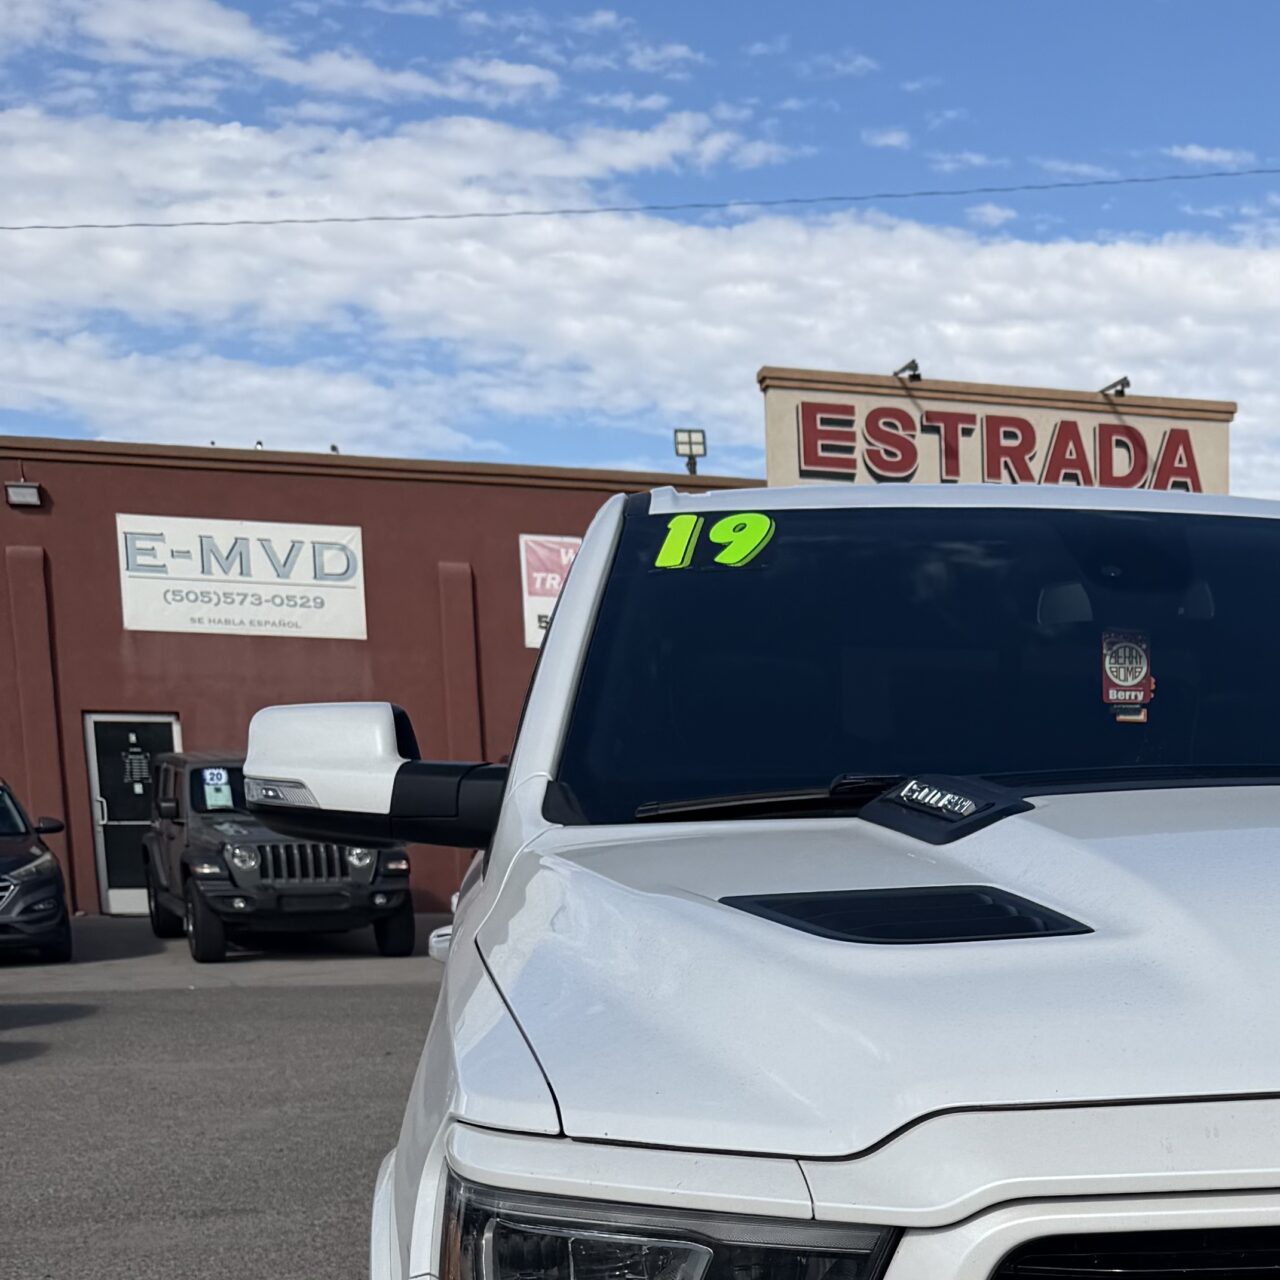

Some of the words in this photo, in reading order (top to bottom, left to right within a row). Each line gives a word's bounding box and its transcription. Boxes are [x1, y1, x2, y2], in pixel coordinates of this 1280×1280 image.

[798, 401, 1203, 493] ESTRADA
[655, 513, 775, 568] 19
[123, 531, 358, 582] E-MVD
[163, 588, 325, 609] (505)573-0529
[190, 617, 204, 625] SE
[208, 618, 246, 627] HABLA
[249, 619, 301, 629] ESPAÑOL
[1108, 689, 1144, 702] Berry
[208, 772, 223, 781] 20
